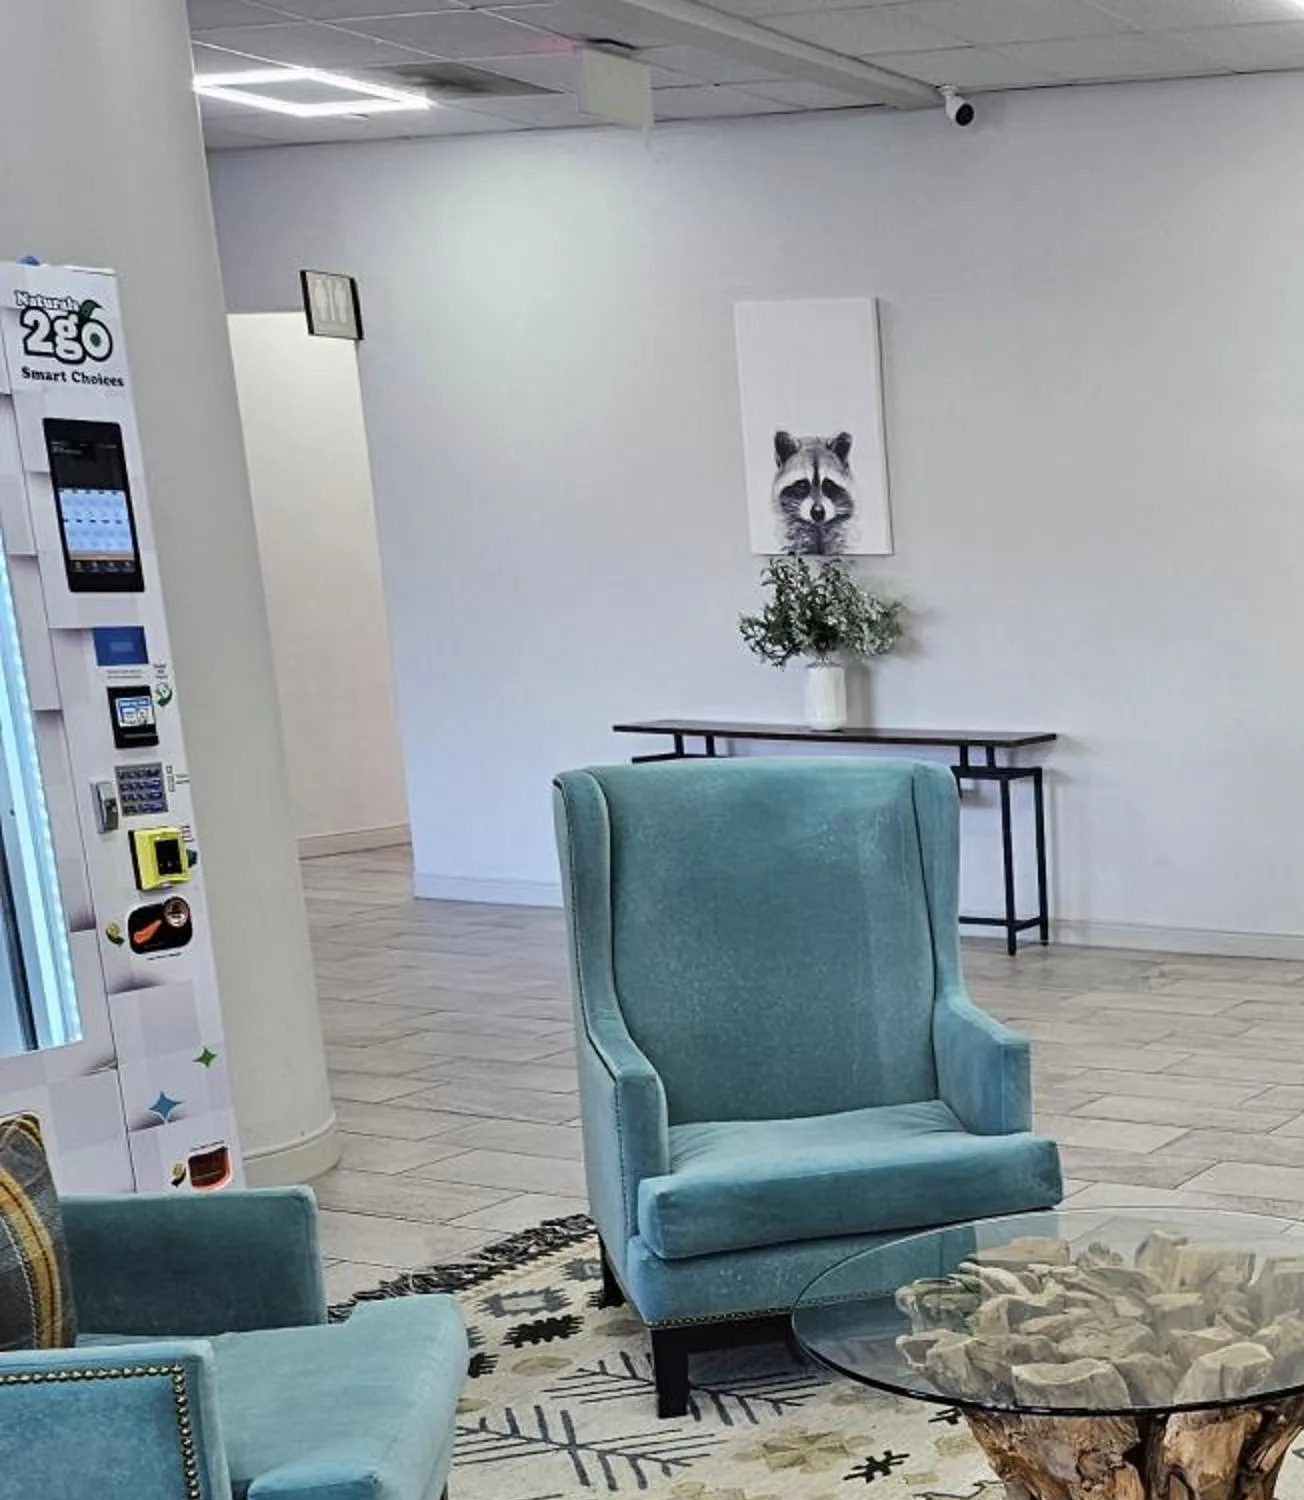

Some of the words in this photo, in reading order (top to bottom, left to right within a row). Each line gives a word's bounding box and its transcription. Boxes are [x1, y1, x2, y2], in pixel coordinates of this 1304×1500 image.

[20, 305, 113, 365] 2go
[21, 366, 67, 382] Smart
[71, 371, 125, 387] Choices
